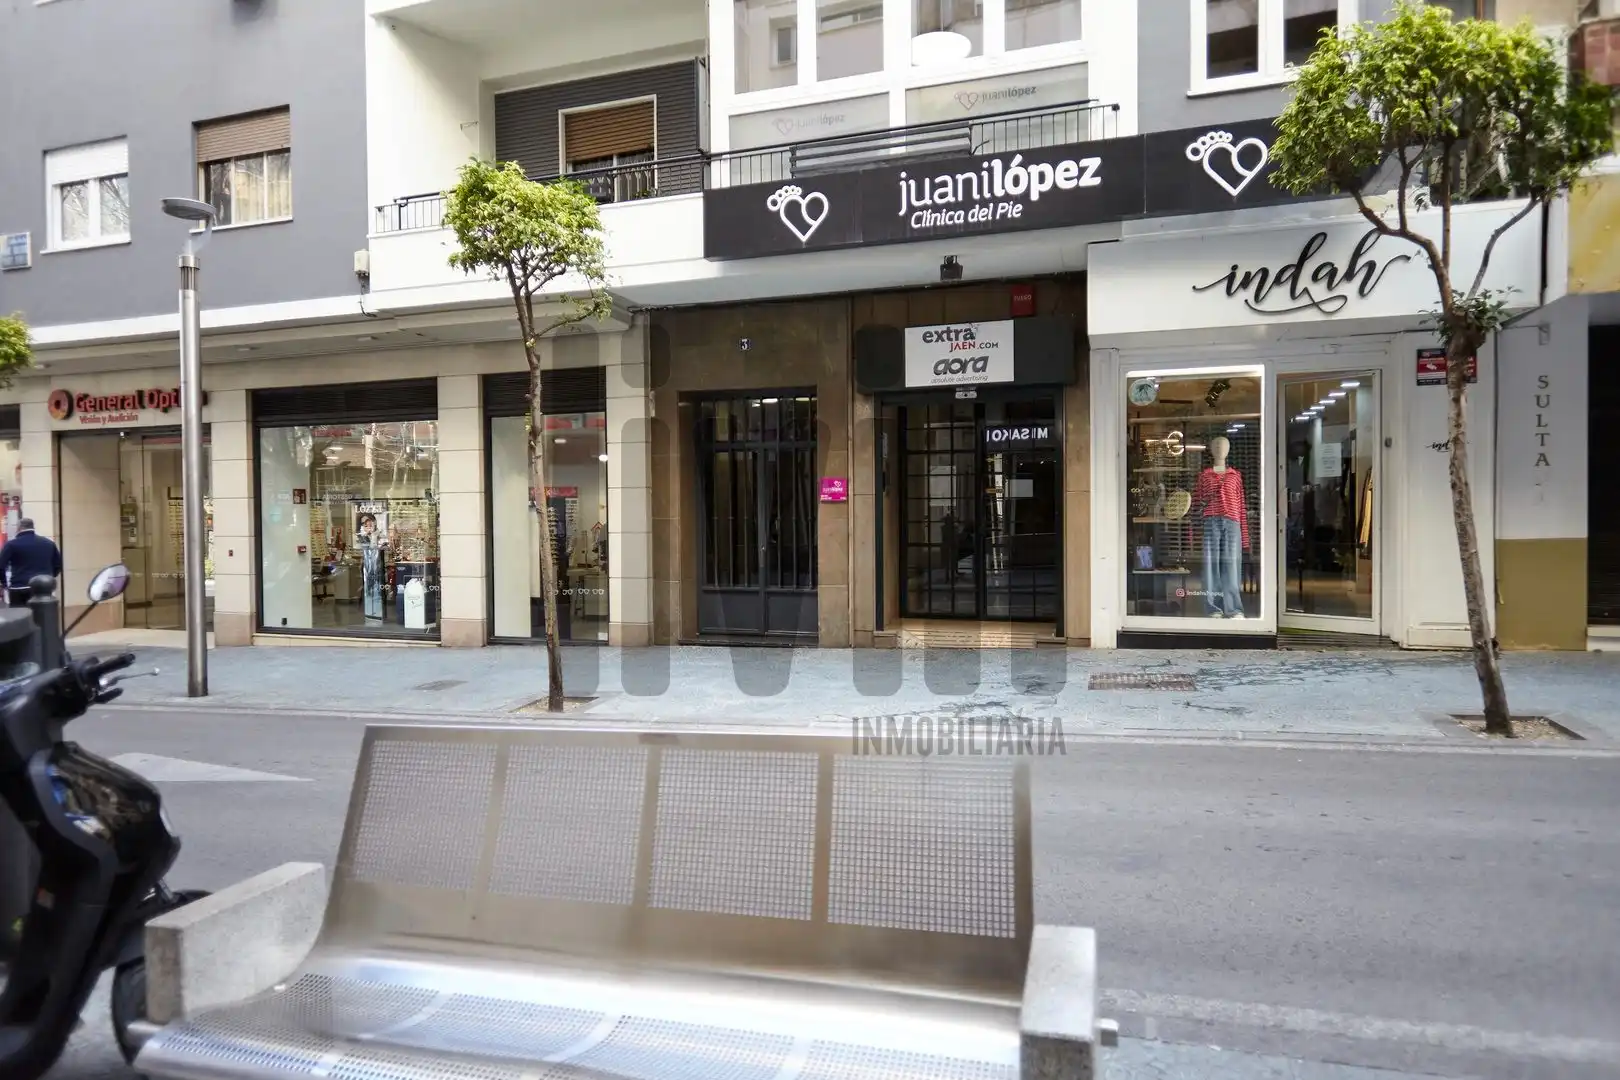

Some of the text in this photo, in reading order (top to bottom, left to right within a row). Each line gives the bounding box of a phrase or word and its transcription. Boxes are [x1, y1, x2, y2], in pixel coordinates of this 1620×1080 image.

[898, 154, 1101, 216] juanilópez
[910, 203, 1023, 230] Clínica del Pie
[1192, 227, 1411, 314] indah
[741, 338, 749, 351] 3
[922, 326, 976, 343] extra
[933, 355, 990, 376] aora
[75, 390, 144, 412] General
[1426, 439, 1450, 452] ind
